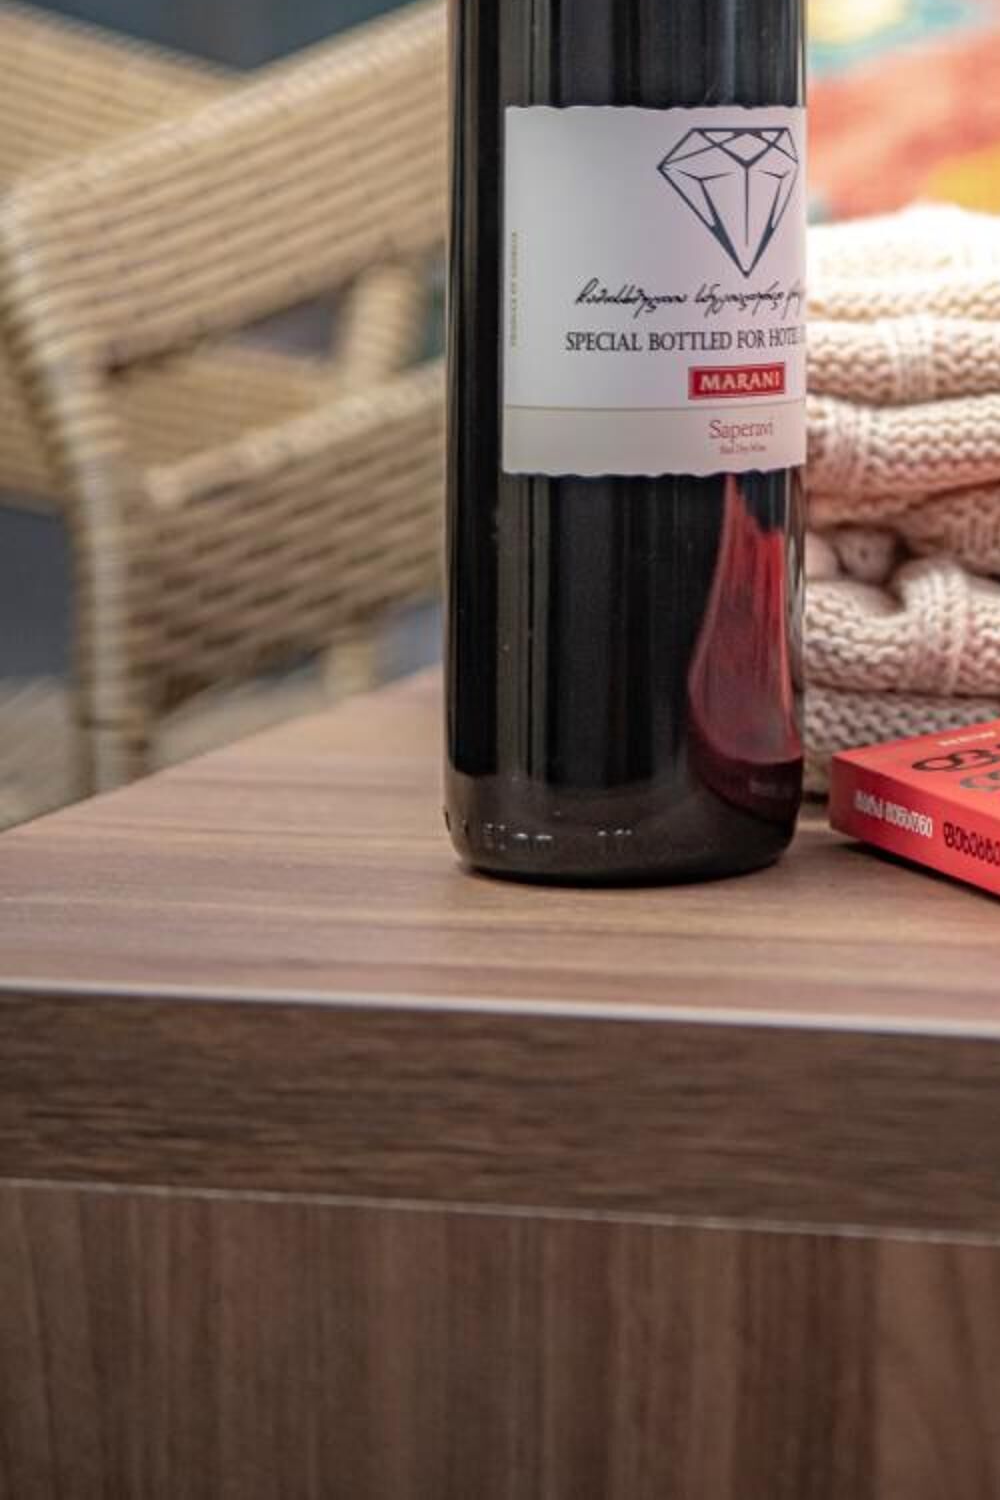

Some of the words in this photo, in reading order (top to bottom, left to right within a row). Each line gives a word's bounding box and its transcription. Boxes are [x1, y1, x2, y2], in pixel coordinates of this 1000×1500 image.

[565, 331, 643, 352] SPECIAL
[648, 331, 732, 352] BOTTLED
[737, 328, 766, 349] FOR
[768, 325, 804, 347] HOTE
[699, 368, 781, 391] MARANI
[708, 418, 774, 443] Saperavi
